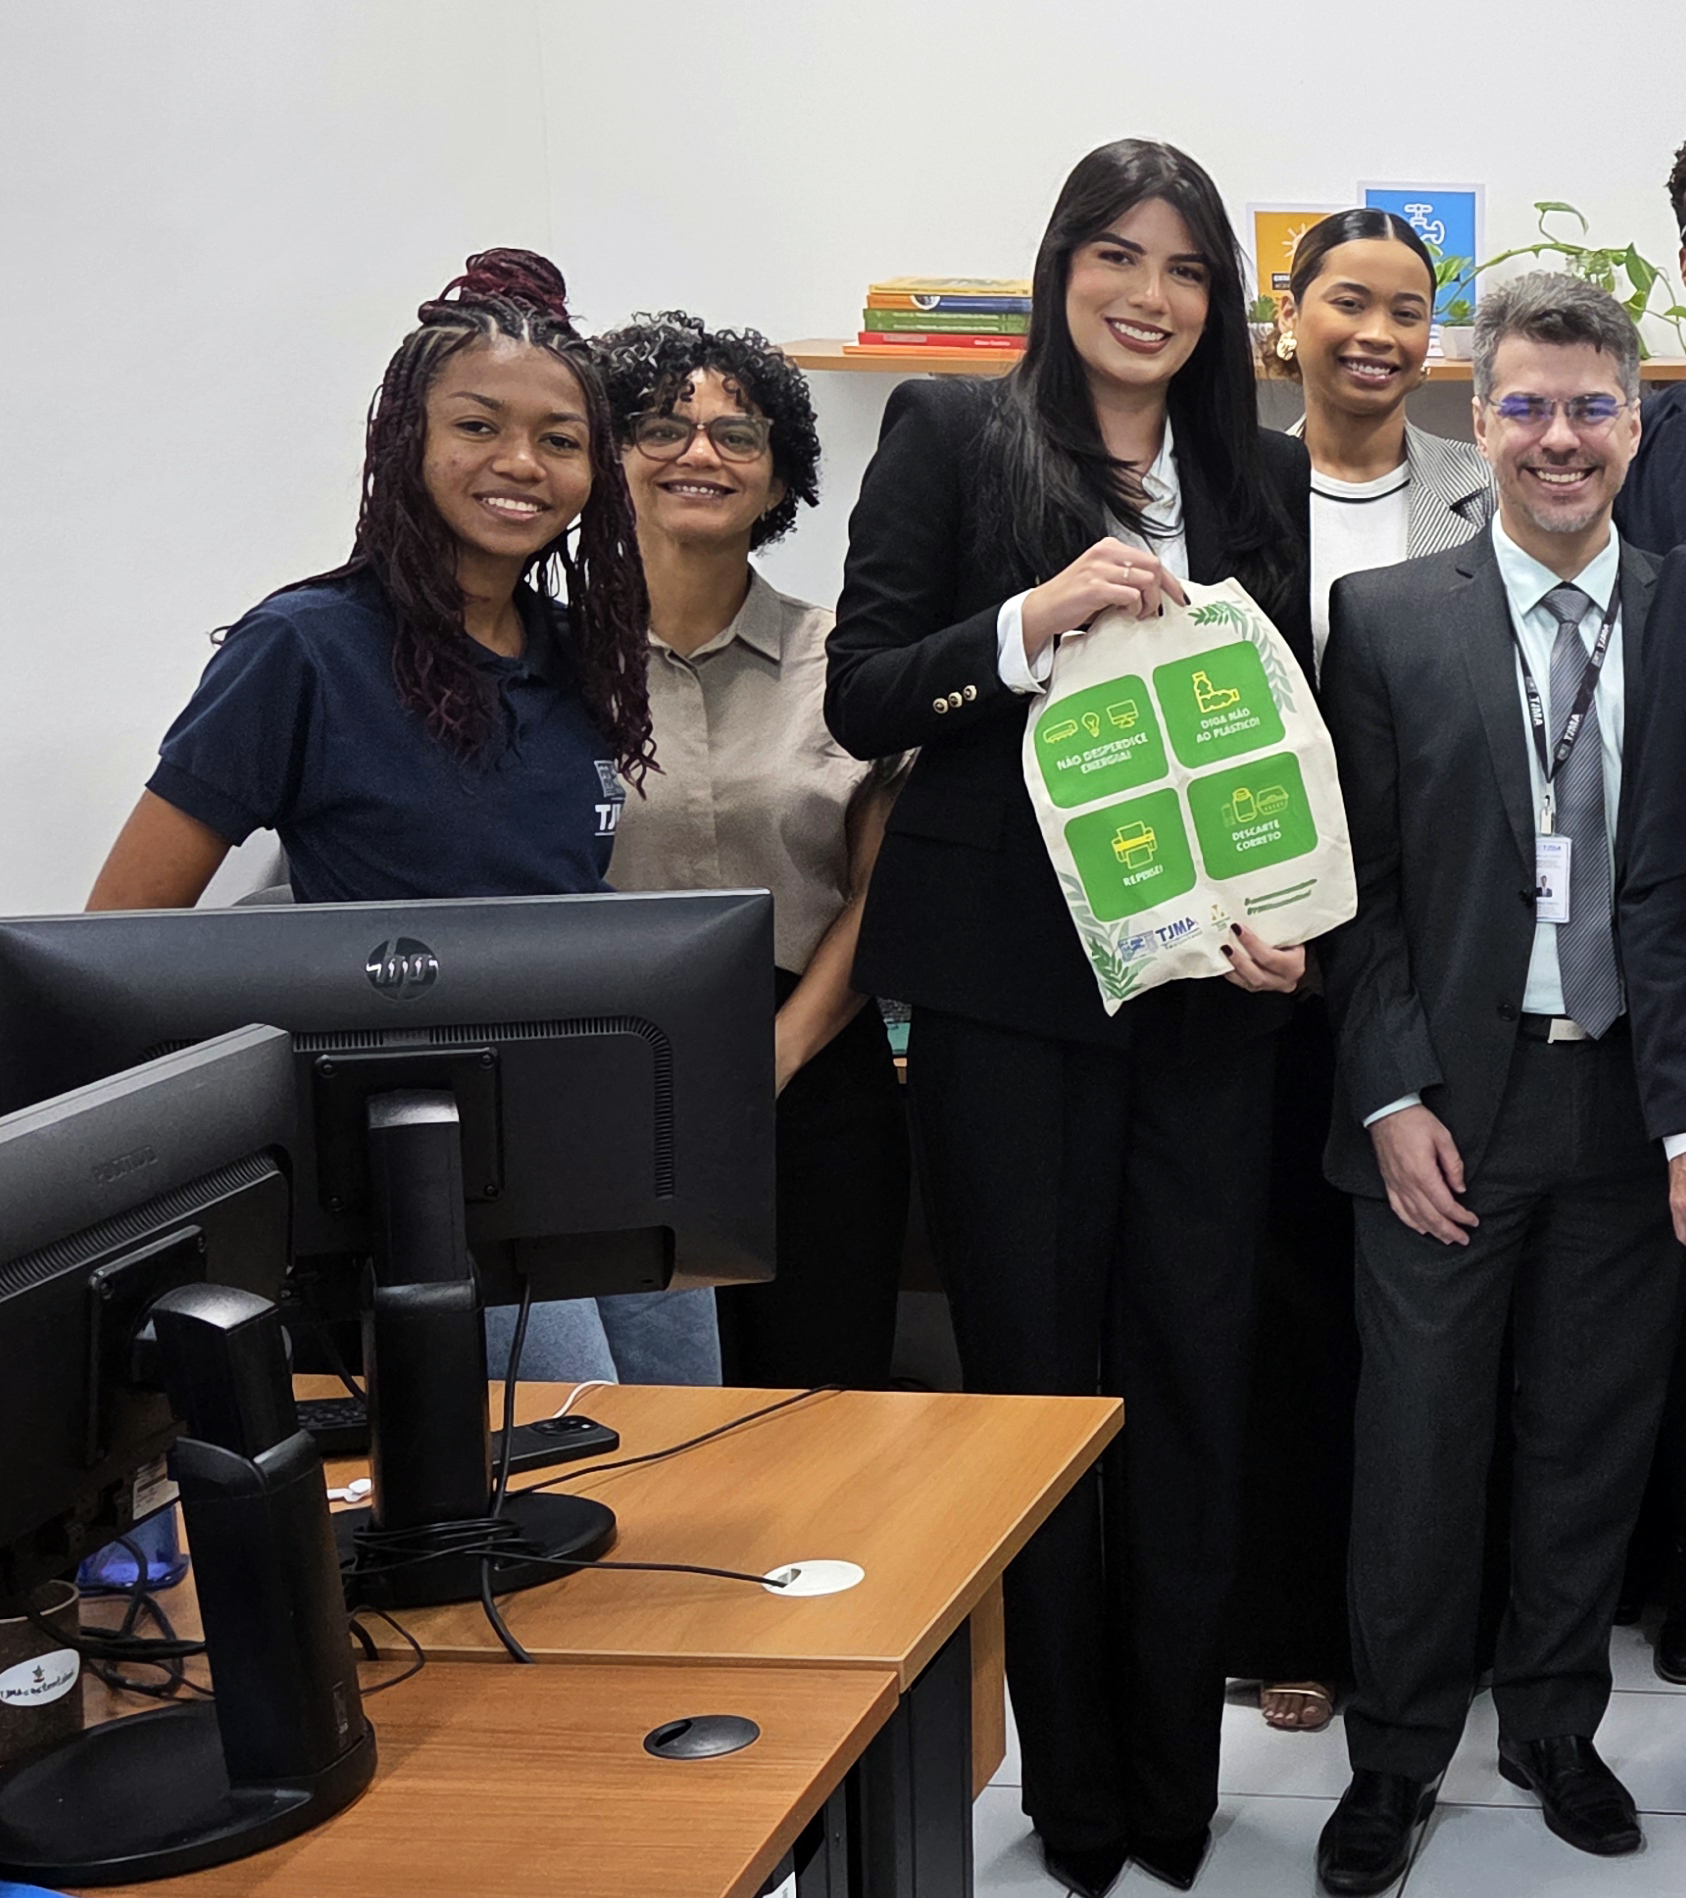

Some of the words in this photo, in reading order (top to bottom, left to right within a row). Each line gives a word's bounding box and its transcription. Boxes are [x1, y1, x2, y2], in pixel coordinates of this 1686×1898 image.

[1529, 695, 1544, 727] TJMA
[1201, 715, 1227, 730] DIGA
[1196, 732, 1212, 744] AO
[1056, 751, 1082, 771] NÃO
[1232, 819, 1281, 842] DESCARTE
[1155, 917, 1196, 942] TJMA
